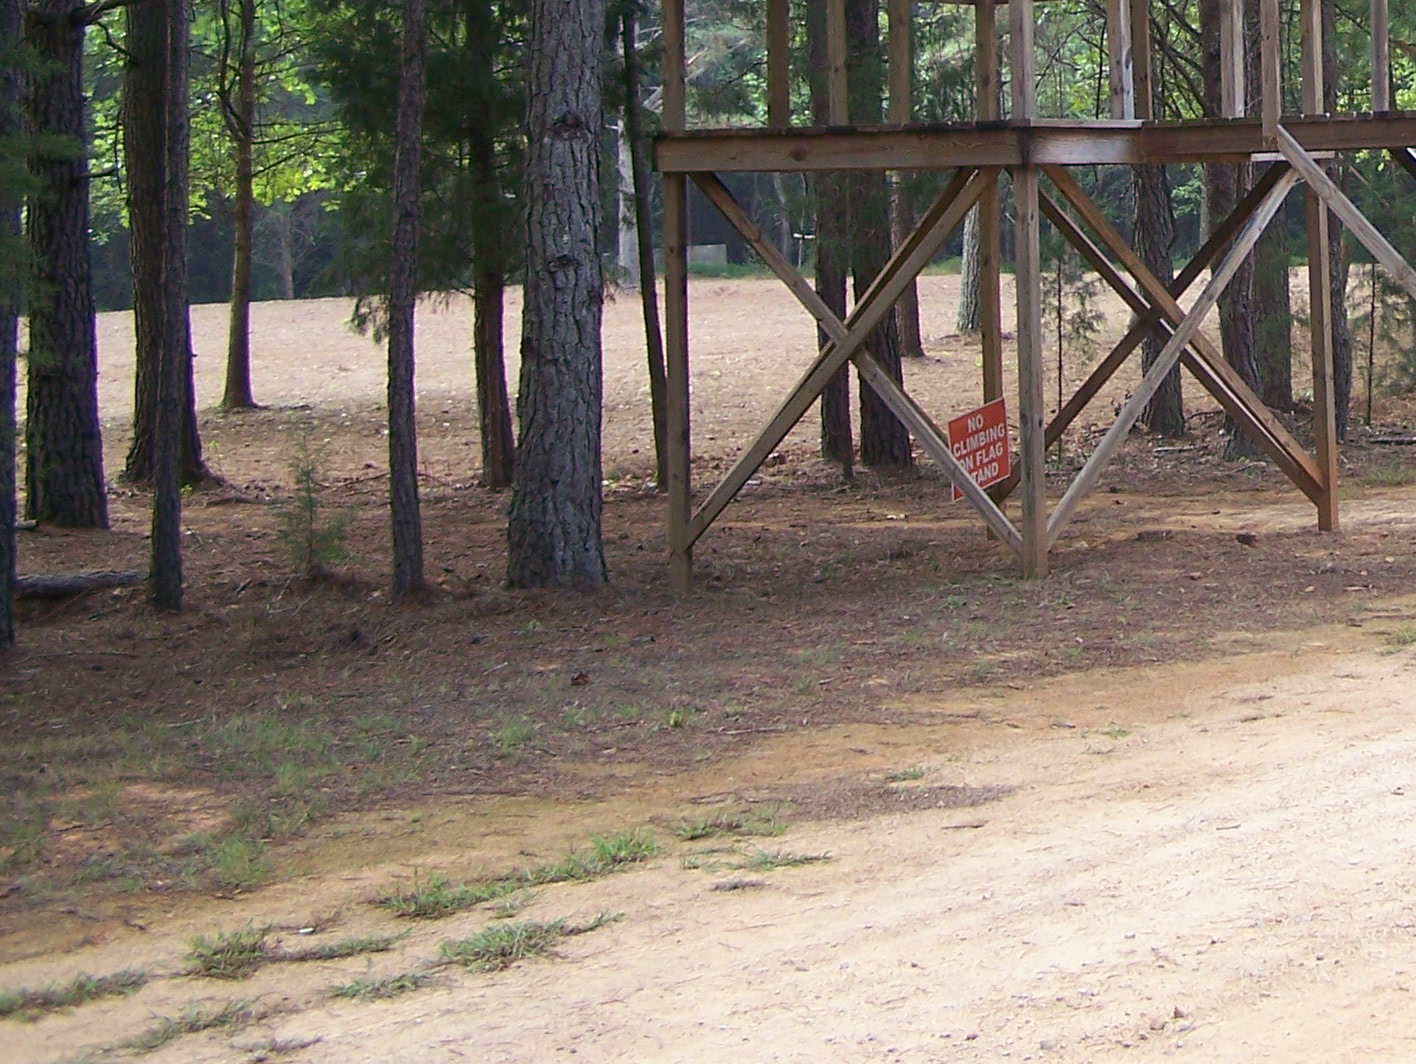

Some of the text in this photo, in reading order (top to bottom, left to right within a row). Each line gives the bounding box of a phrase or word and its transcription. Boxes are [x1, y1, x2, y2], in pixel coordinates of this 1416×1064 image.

[967, 414, 984, 433] NO
[953, 423, 1005, 456] CLIMBING
[976, 442, 1003, 466] FLAG
[971, 462, 998, 484] TAND
